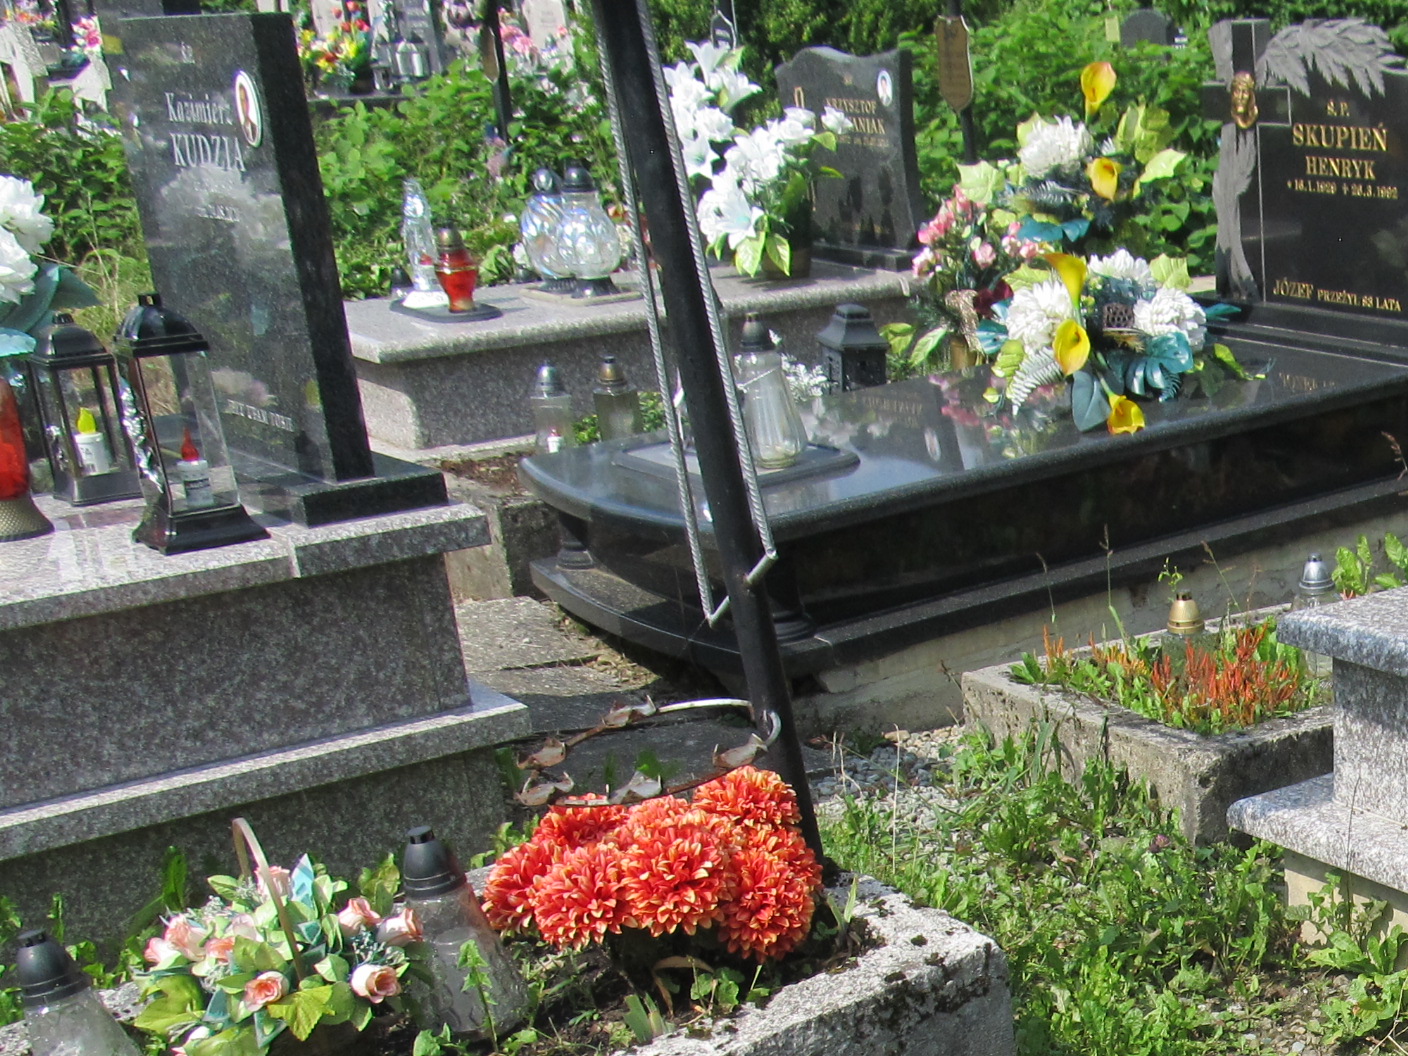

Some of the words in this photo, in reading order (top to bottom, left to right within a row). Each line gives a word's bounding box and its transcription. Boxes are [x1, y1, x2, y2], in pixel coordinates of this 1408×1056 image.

[1292, 121, 1388, 152] SKUPIEŃ
[1305, 155, 1376, 180] HENRYK
[1273, 277, 1314, 299] JÓZEF
[1375, 296, 1402, 312] LATA
